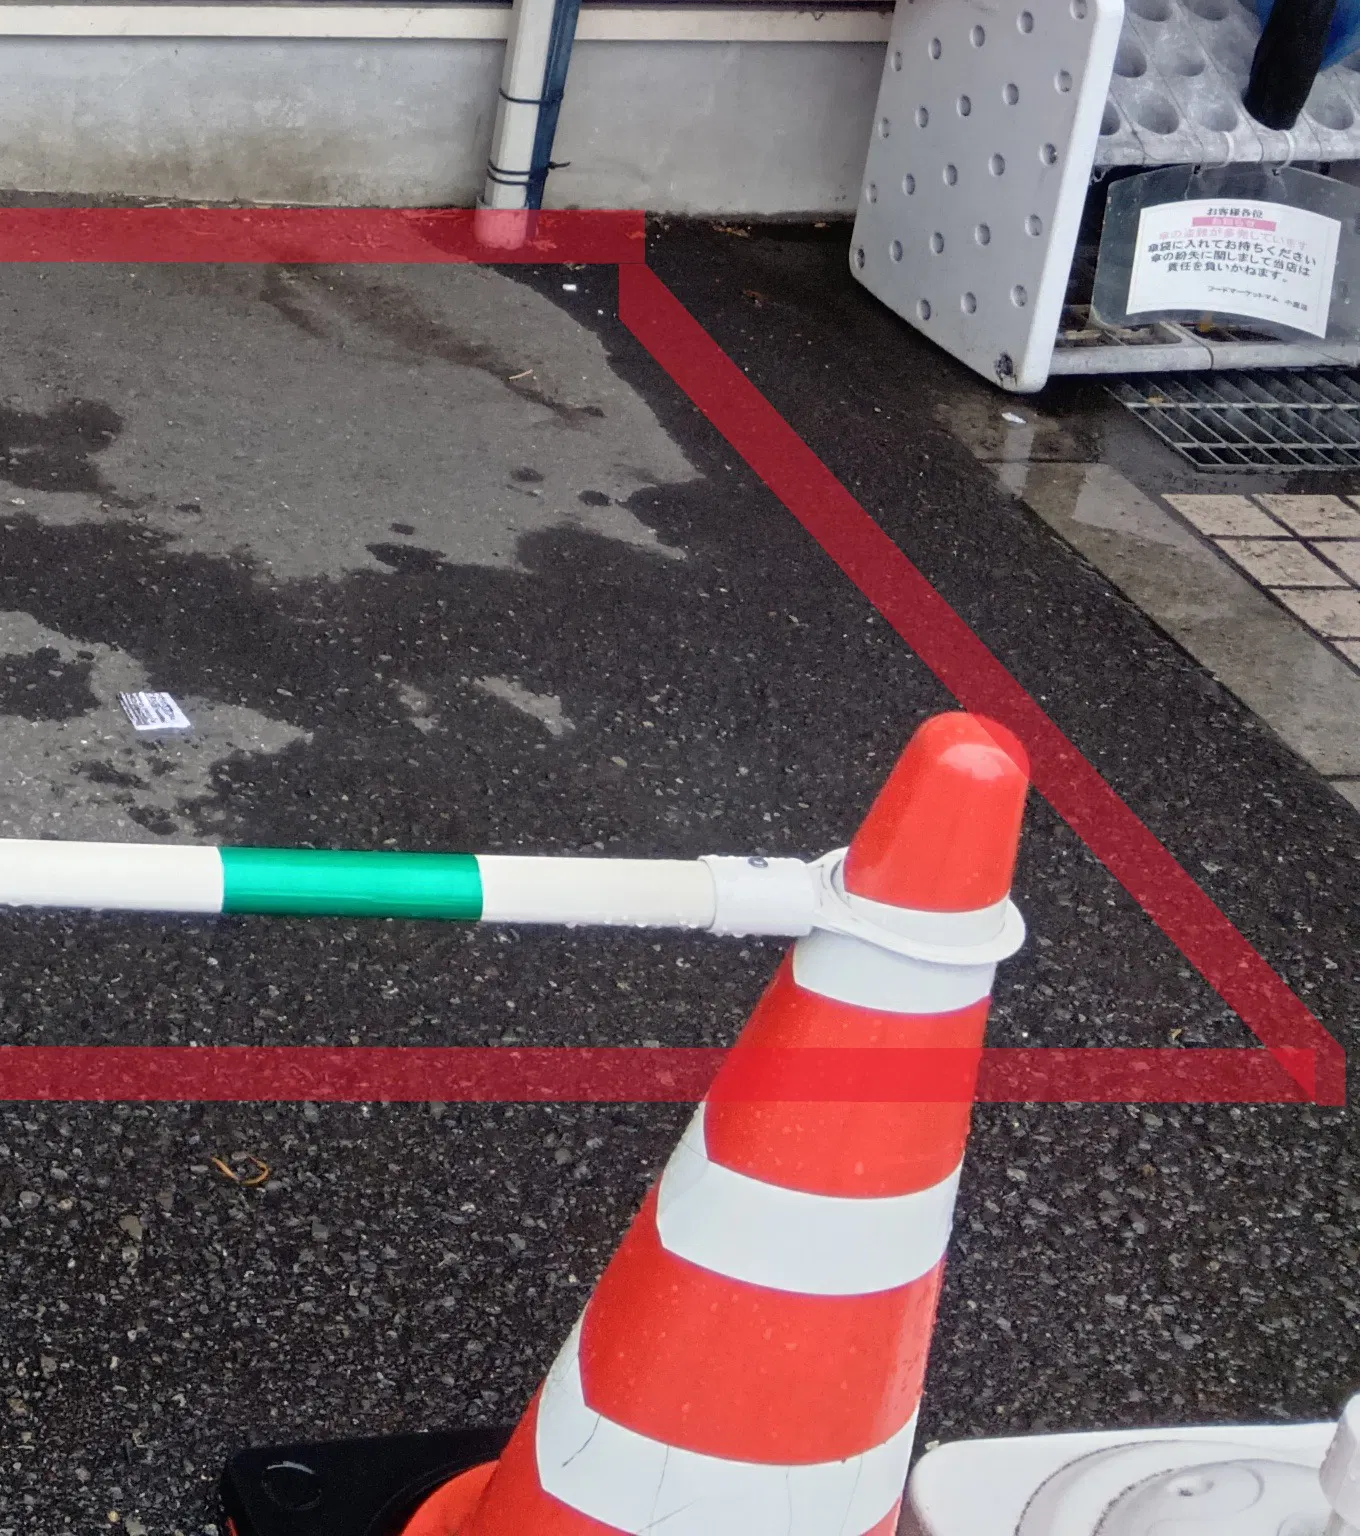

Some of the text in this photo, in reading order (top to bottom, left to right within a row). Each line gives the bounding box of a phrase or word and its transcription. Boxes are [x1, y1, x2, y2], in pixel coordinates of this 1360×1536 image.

[1206, 206, 1264, 220] お客様各位
[1150, 250, 1312, 277] 傘の紛失に関しまして当店は
[1166, 261, 1289, 284] 責任を負いかねます。
